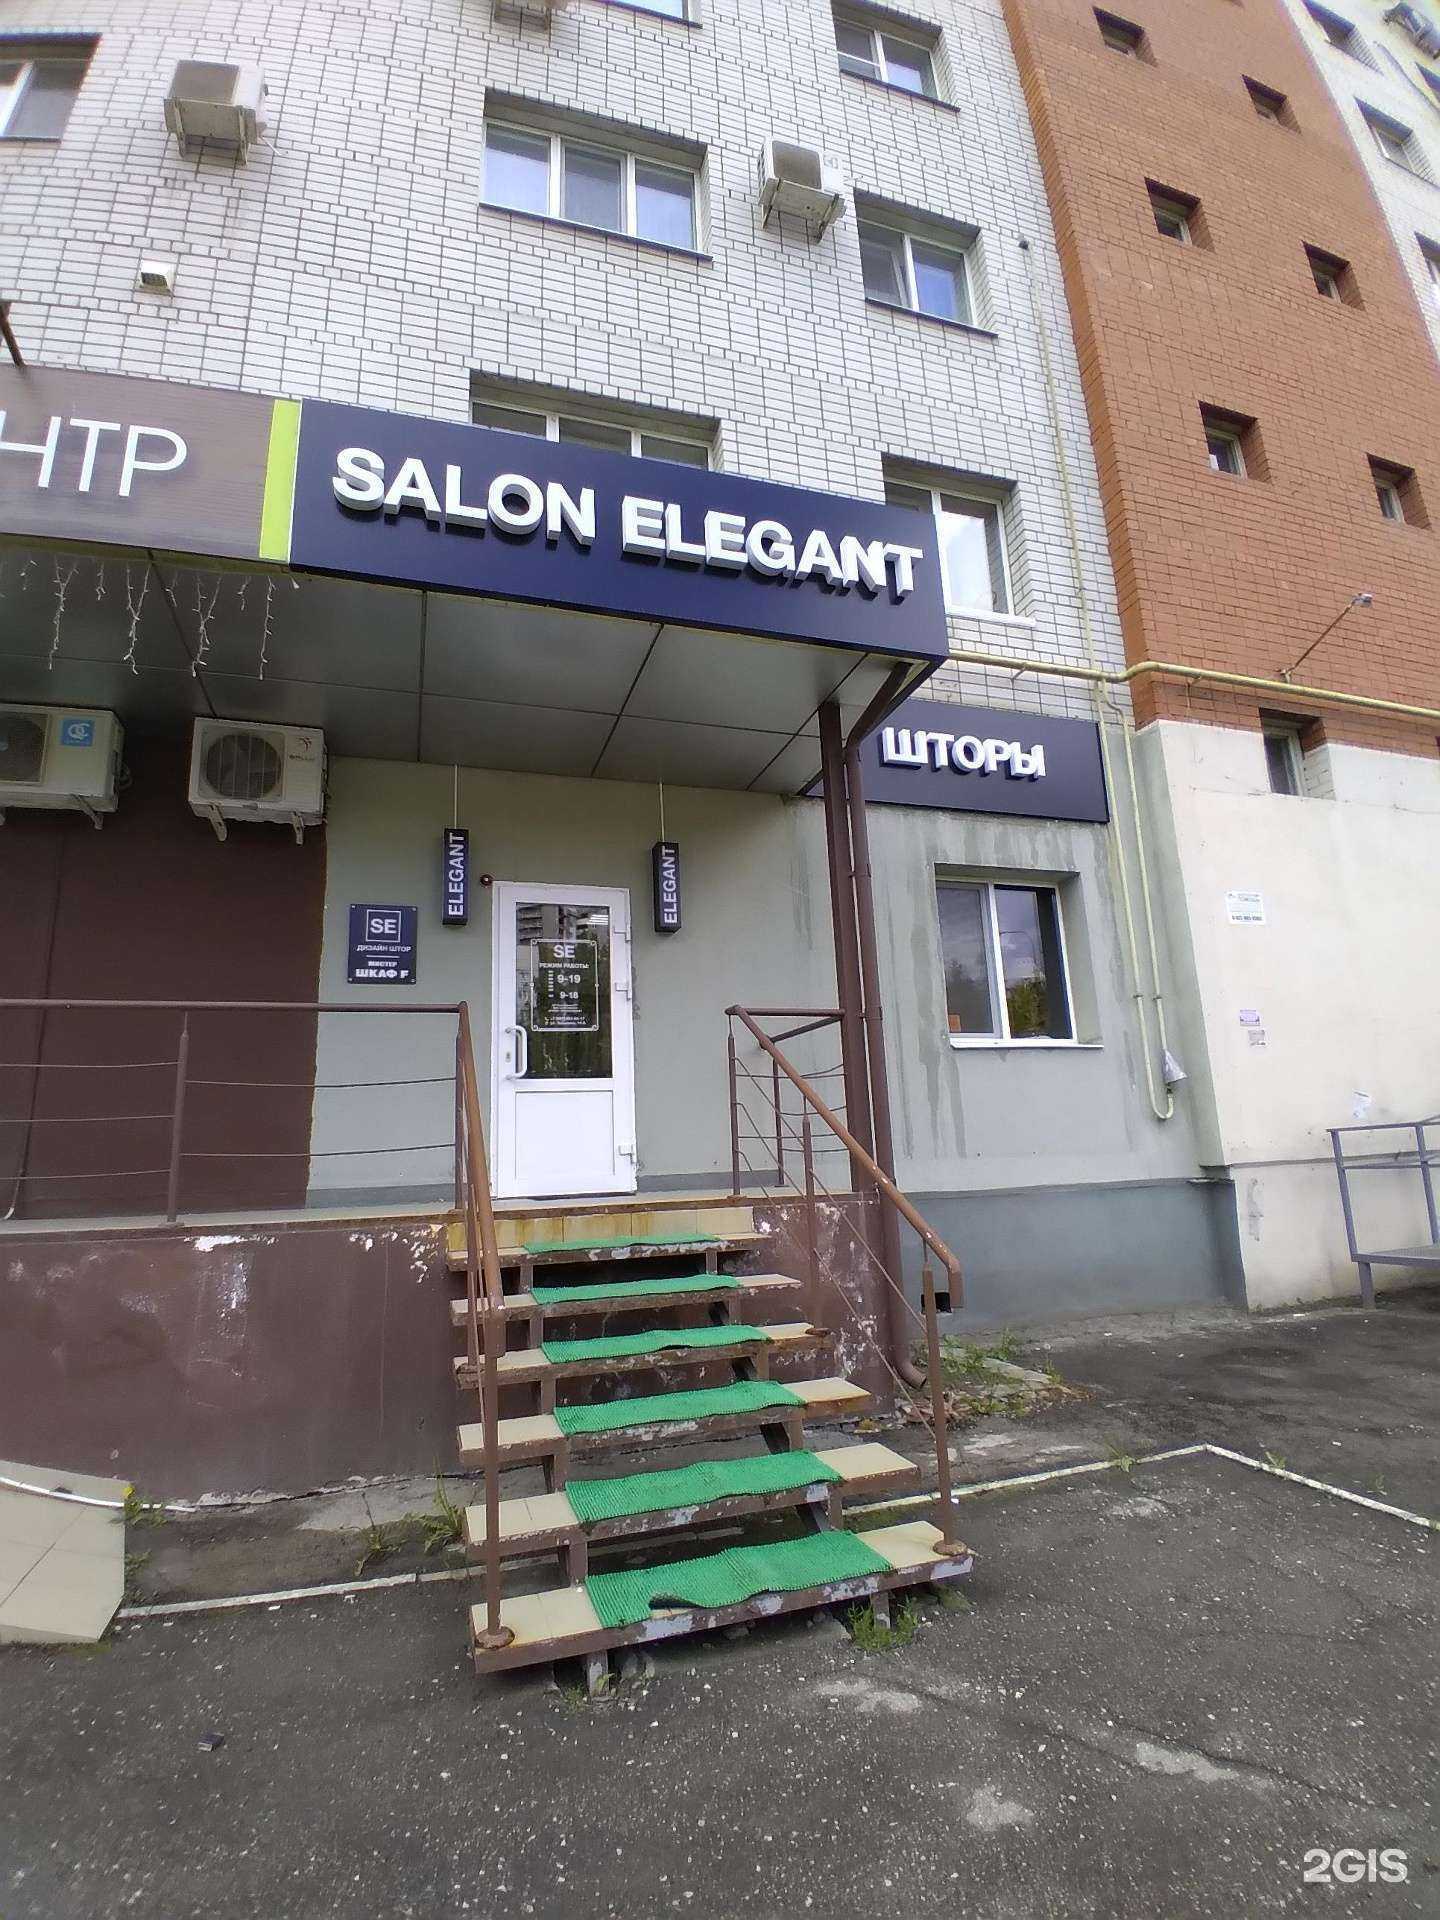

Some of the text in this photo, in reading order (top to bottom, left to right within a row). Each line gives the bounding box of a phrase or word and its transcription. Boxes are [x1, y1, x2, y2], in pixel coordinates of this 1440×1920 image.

[332, 447, 924, 599] SALON ELEGANT
[882, 726, 1047, 779] ШТОРЫ
[448, 832, 465, 916] ELEGANT
[661, 846, 679, 924] ELEGANT
[369, 918, 397, 934] SE
[356, 944, 388, 952] ДИЗАЙН
[553, 944, 576, 959] SE
[355, 968, 398, 979] ШКАФ
[557, 974, 581, 984] 9-19
[560, 991, 579, 999] 9-18
